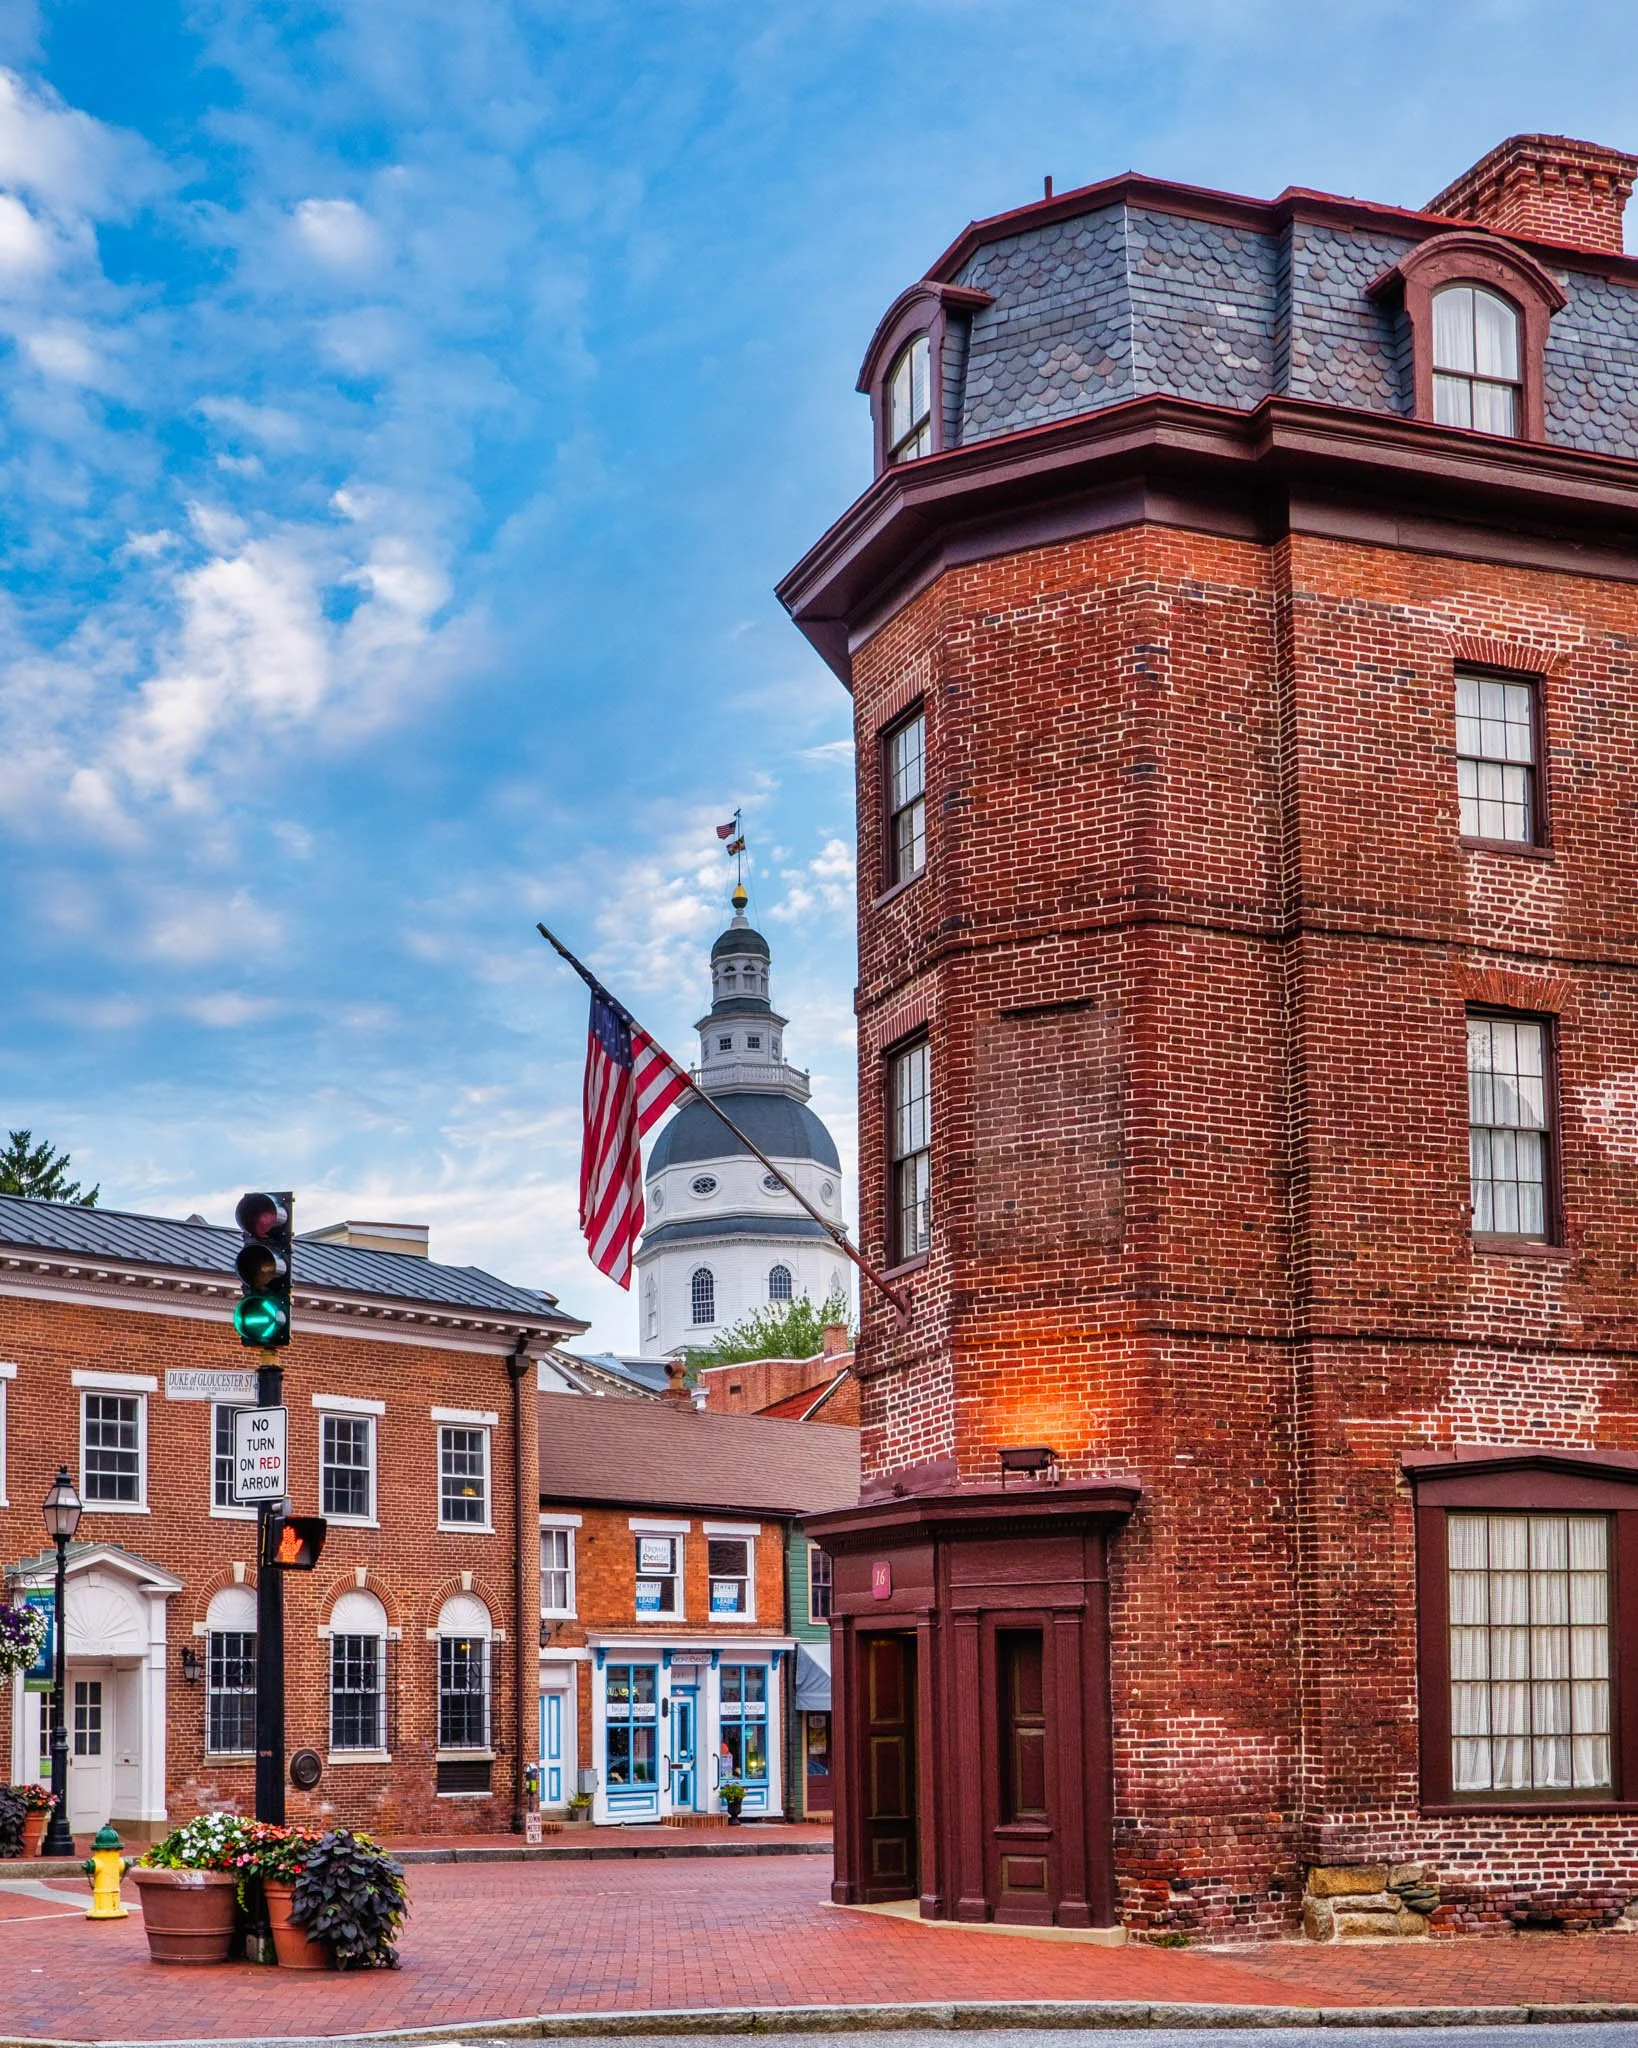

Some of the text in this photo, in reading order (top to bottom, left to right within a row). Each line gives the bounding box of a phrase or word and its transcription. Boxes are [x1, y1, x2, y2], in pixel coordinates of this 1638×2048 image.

[169, 1373, 254, 1388] DUKE of GLOUCESTER ST
[252, 1419, 269, 1432] NO
[247, 1437, 275, 1452] TURN
[240, 1456, 281, 1471] ON RED
[241, 1475, 280, 1491] ARROW
[875, 1568, 886, 1586] 16
